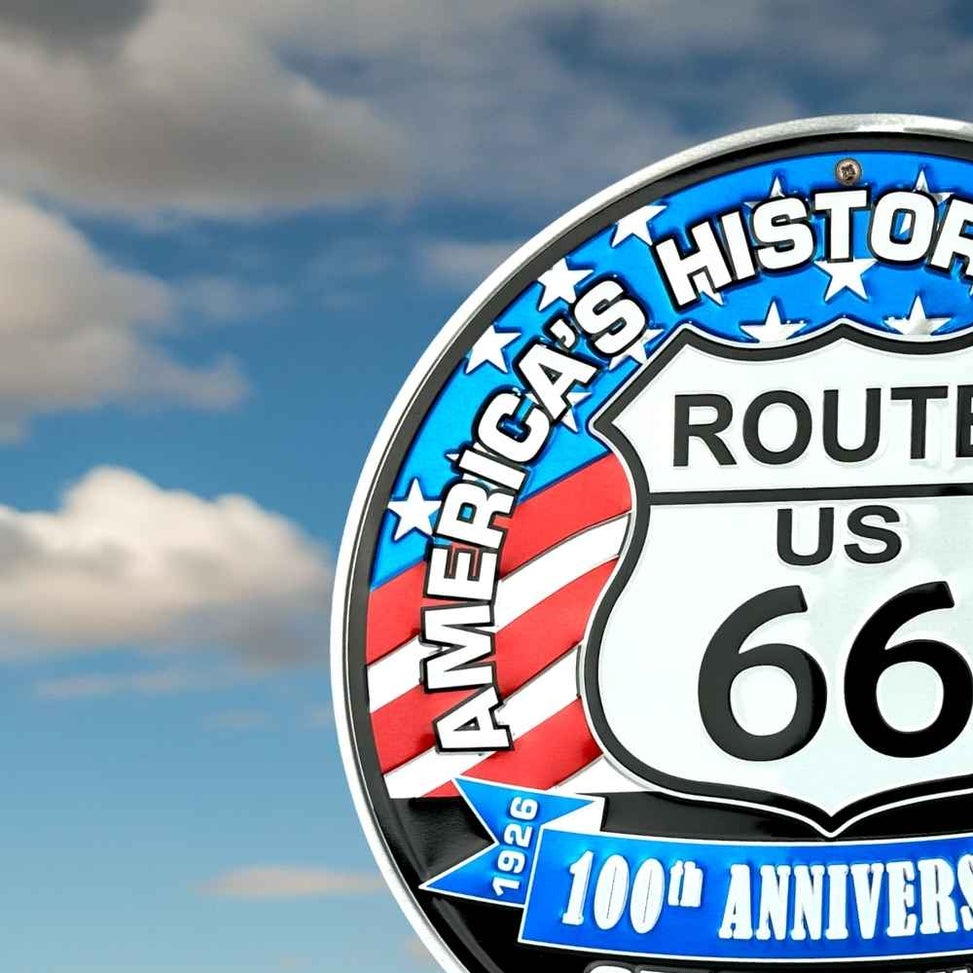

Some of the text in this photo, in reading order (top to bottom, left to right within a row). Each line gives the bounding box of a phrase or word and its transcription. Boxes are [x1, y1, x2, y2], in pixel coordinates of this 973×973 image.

[423, 279, 648, 751] AMERICA'S
[776, 505, 901, 566] US
[492, 796, 540, 896] 1926
[561, 850, 704, 934] 100th
